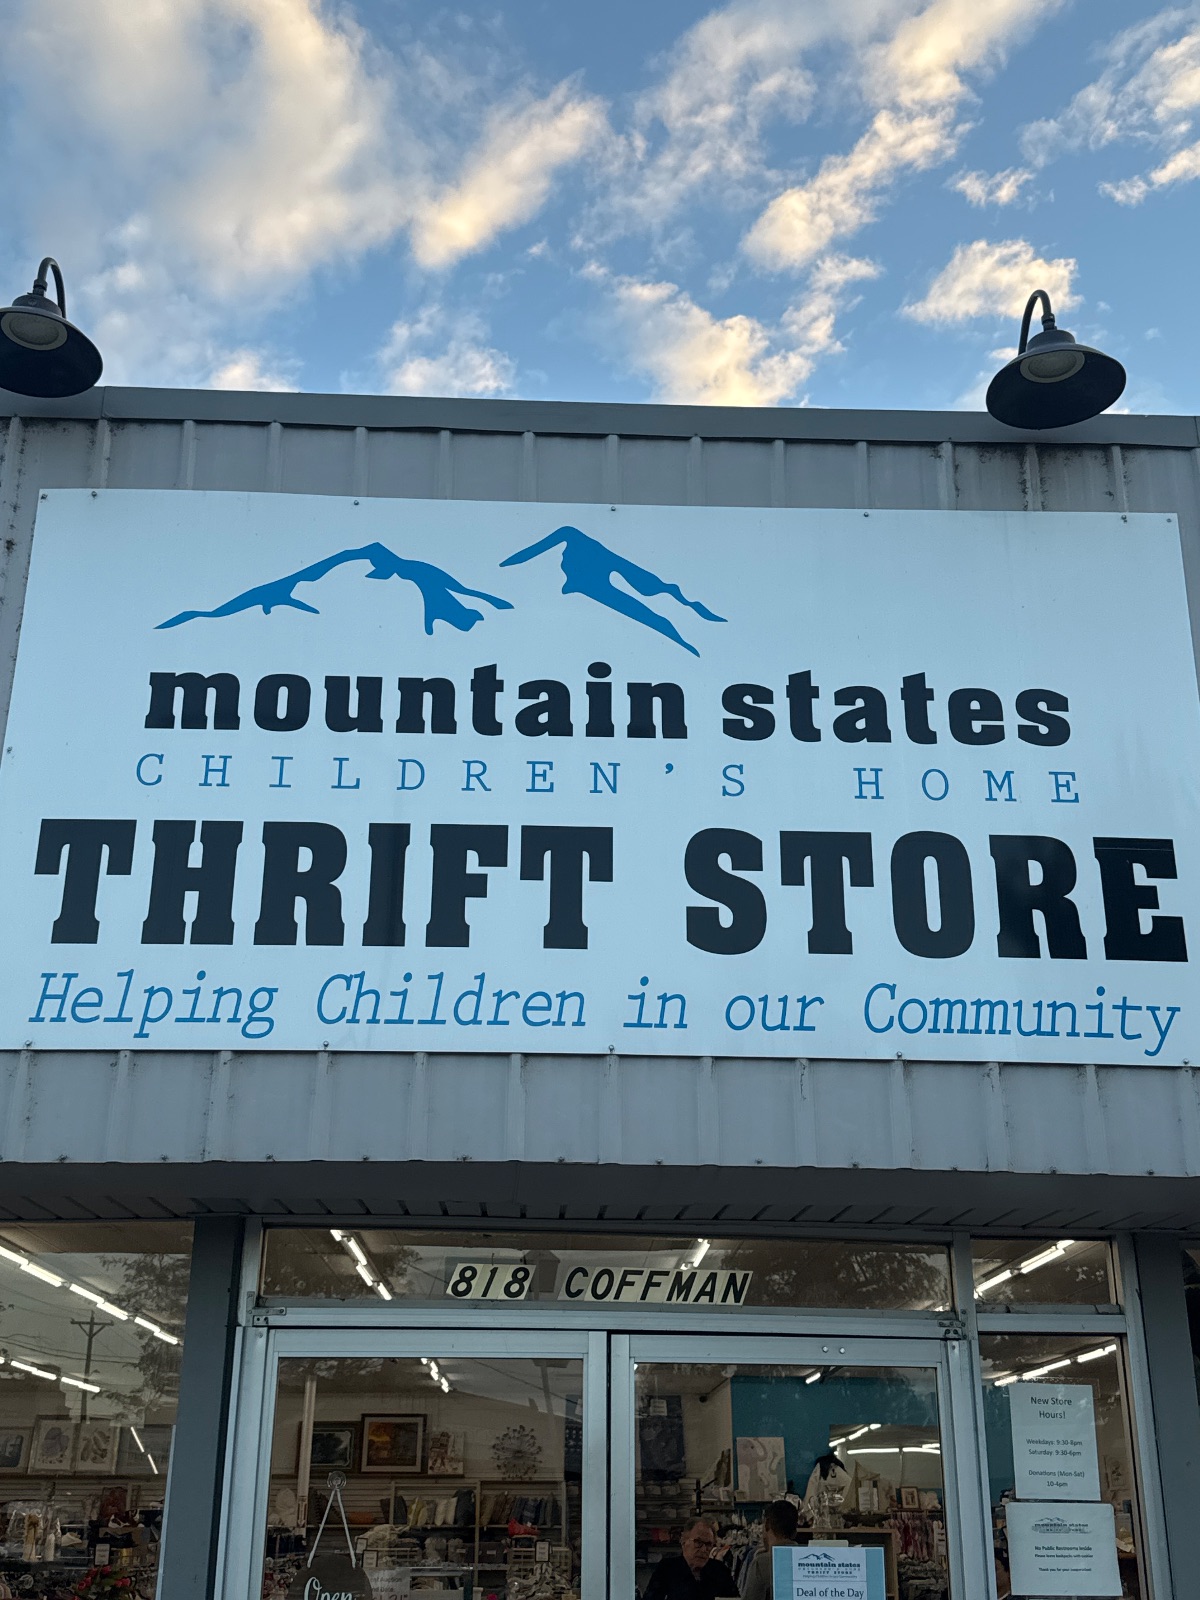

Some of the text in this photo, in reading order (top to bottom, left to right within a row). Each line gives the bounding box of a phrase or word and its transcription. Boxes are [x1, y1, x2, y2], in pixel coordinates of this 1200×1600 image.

[145, 661, 1071, 746] mountain states
[136, 753, 1079, 803] CHILDREN'S HOME
[34, 818, 1188, 962] THRIFT STORE
[29, 969, 1181, 1056] Helping Children in our Community
[451, 1265, 750, 1304] 818 COFFMAN
[1030, 1396, 1072, 1406] New Store
[1039, 1410, 1066, 1419] Hours!
[1028, 1469, 1085, 1478] Donations (Mon-Sat)
[796, 1587, 864, 1599] Deal of the Day
